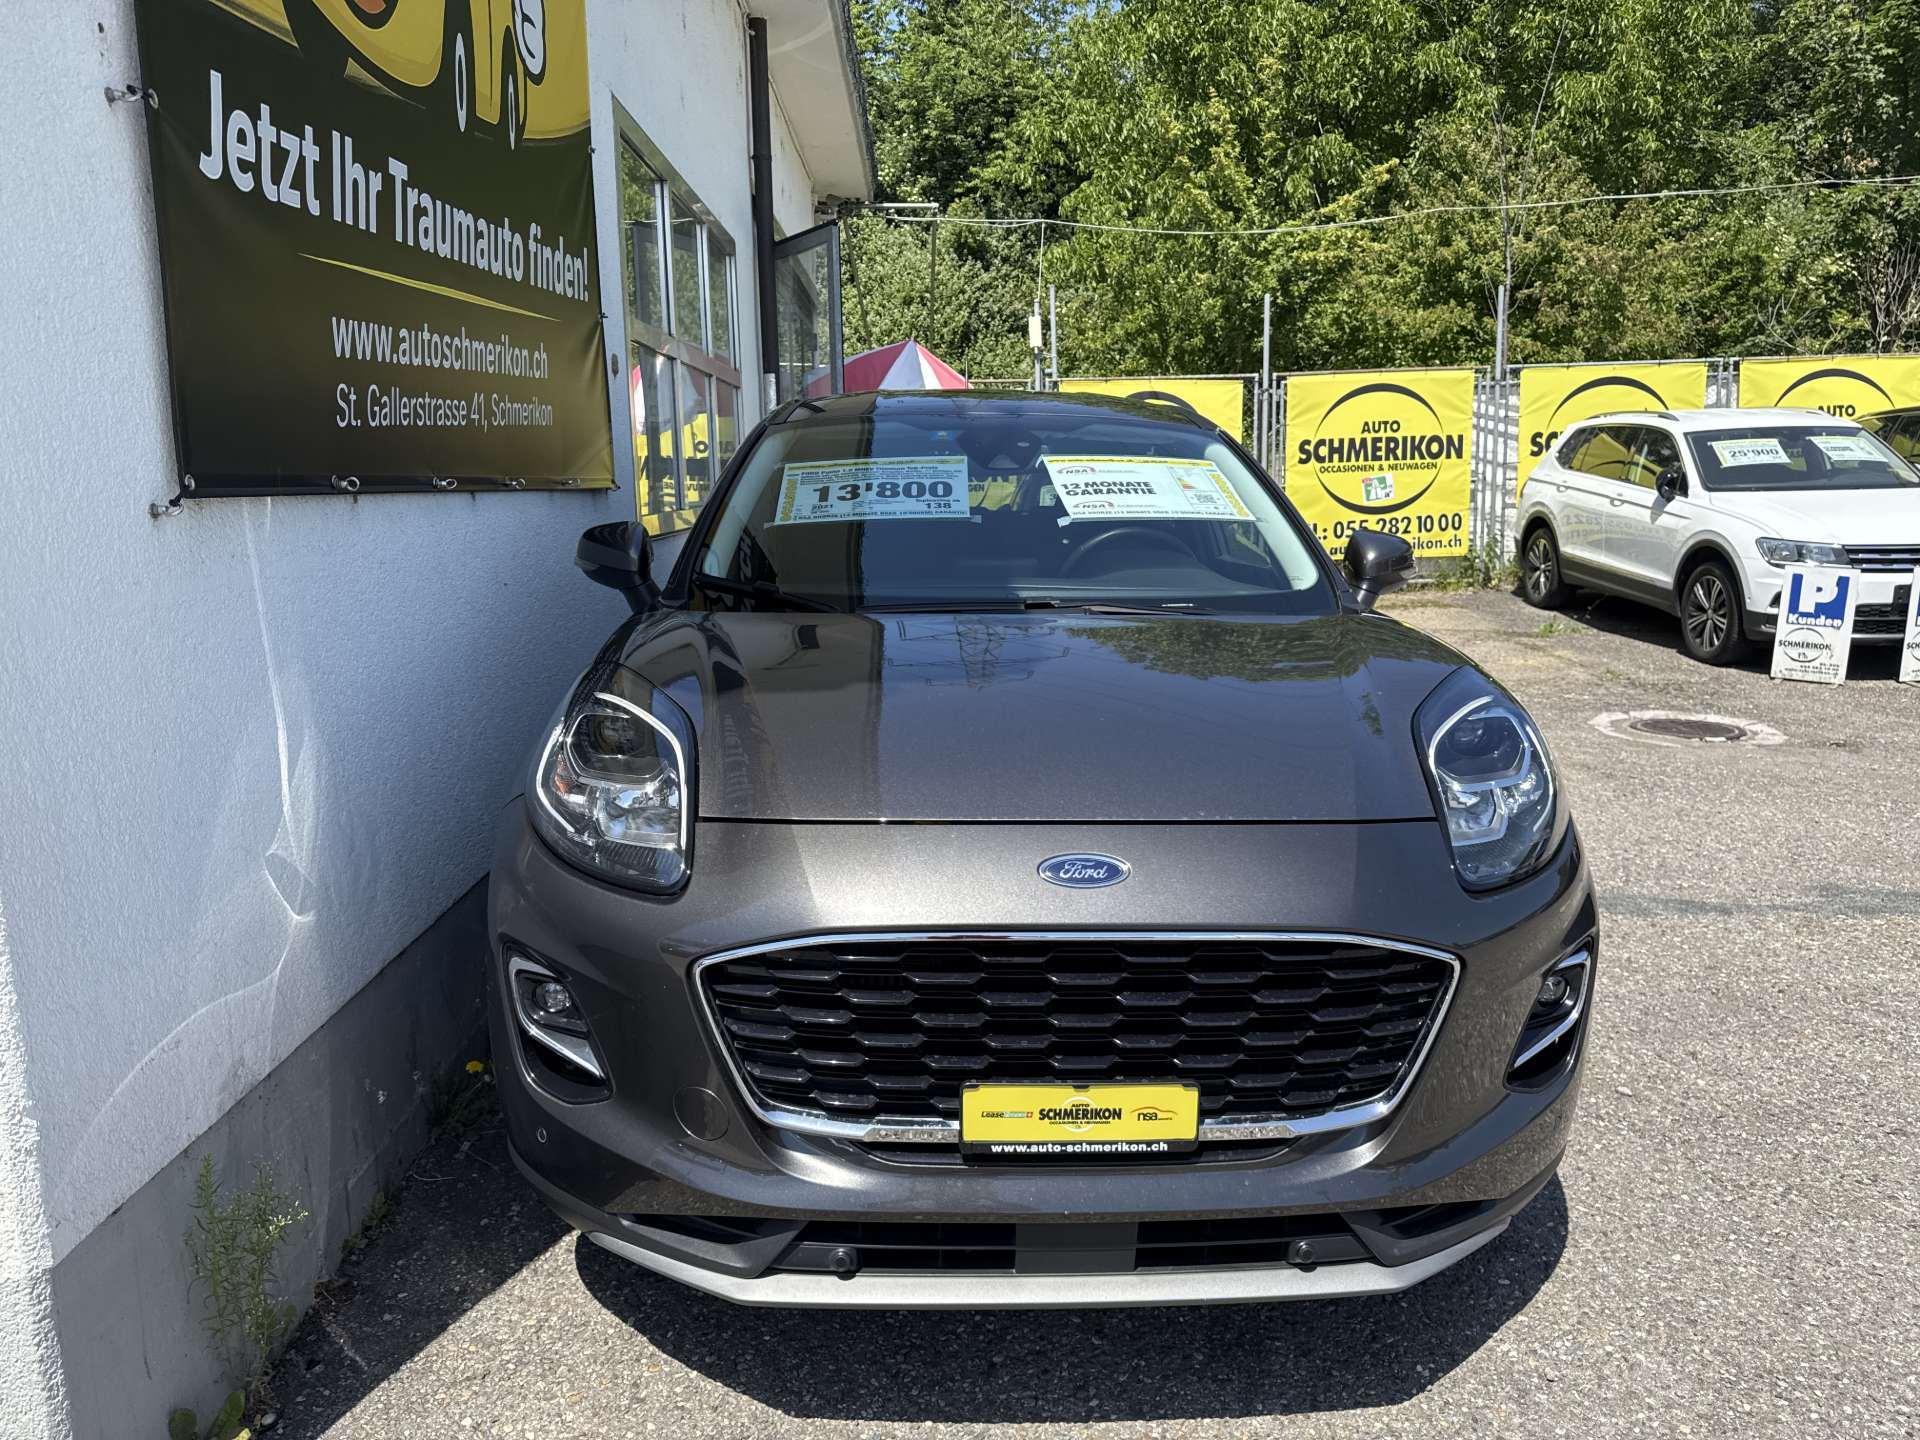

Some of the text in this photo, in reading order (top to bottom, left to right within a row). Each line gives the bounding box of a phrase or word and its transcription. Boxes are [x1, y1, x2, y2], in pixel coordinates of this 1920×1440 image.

[199, 69, 588, 302] Jetzt Ihr Traumauto finden!
[332, 316, 549, 379] www.autoschmerikon.ch
[336, 383, 553, 433] St. Gallerstrasse 41, Schmerikon
[1361, 420, 1401, 434] AUTO
[1297, 434, 1464, 465] SCHMERIKON
[1319, 461, 1438, 474] OCCASIONEN & NEUWAGEN
[813, 480, 953, 503] 13'800
[1060, 480, 1153, 491] 12 MONATE
[1065, 487, 1158, 497] GARANTIE
[1376, 516, 1412, 534] 282
[1788, 613, 1843, 629] Kunden
[1778, 639, 1832, 651] SCHMERIKON
[1059, 860, 1108, 879] Ford
[1039, 1107, 1122, 1121] SCHMERIKON
[1137, 1112, 1158, 1121] nsa
[991, 1142, 1169, 1153] www.auto-schmerikon.ch
